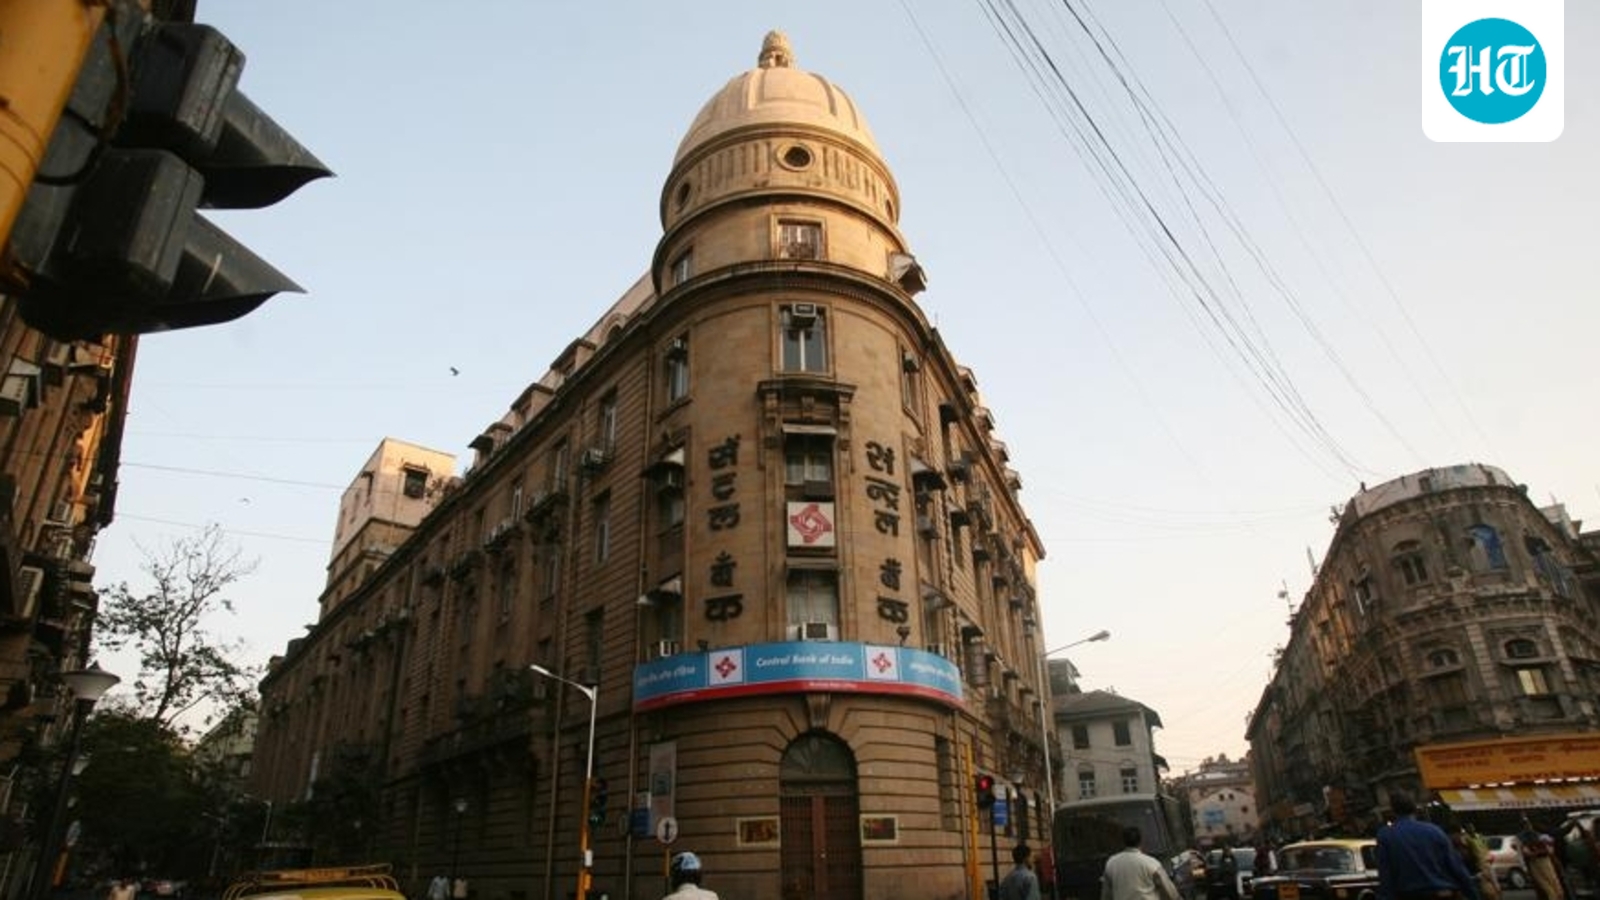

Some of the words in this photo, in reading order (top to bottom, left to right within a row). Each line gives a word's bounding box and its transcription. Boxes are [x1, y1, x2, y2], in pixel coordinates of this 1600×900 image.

[756, 655, 791, 668] Central
[792, 653, 816, 664] Bank
[819, 653, 830, 663] of
[831, 654, 854, 665] India
